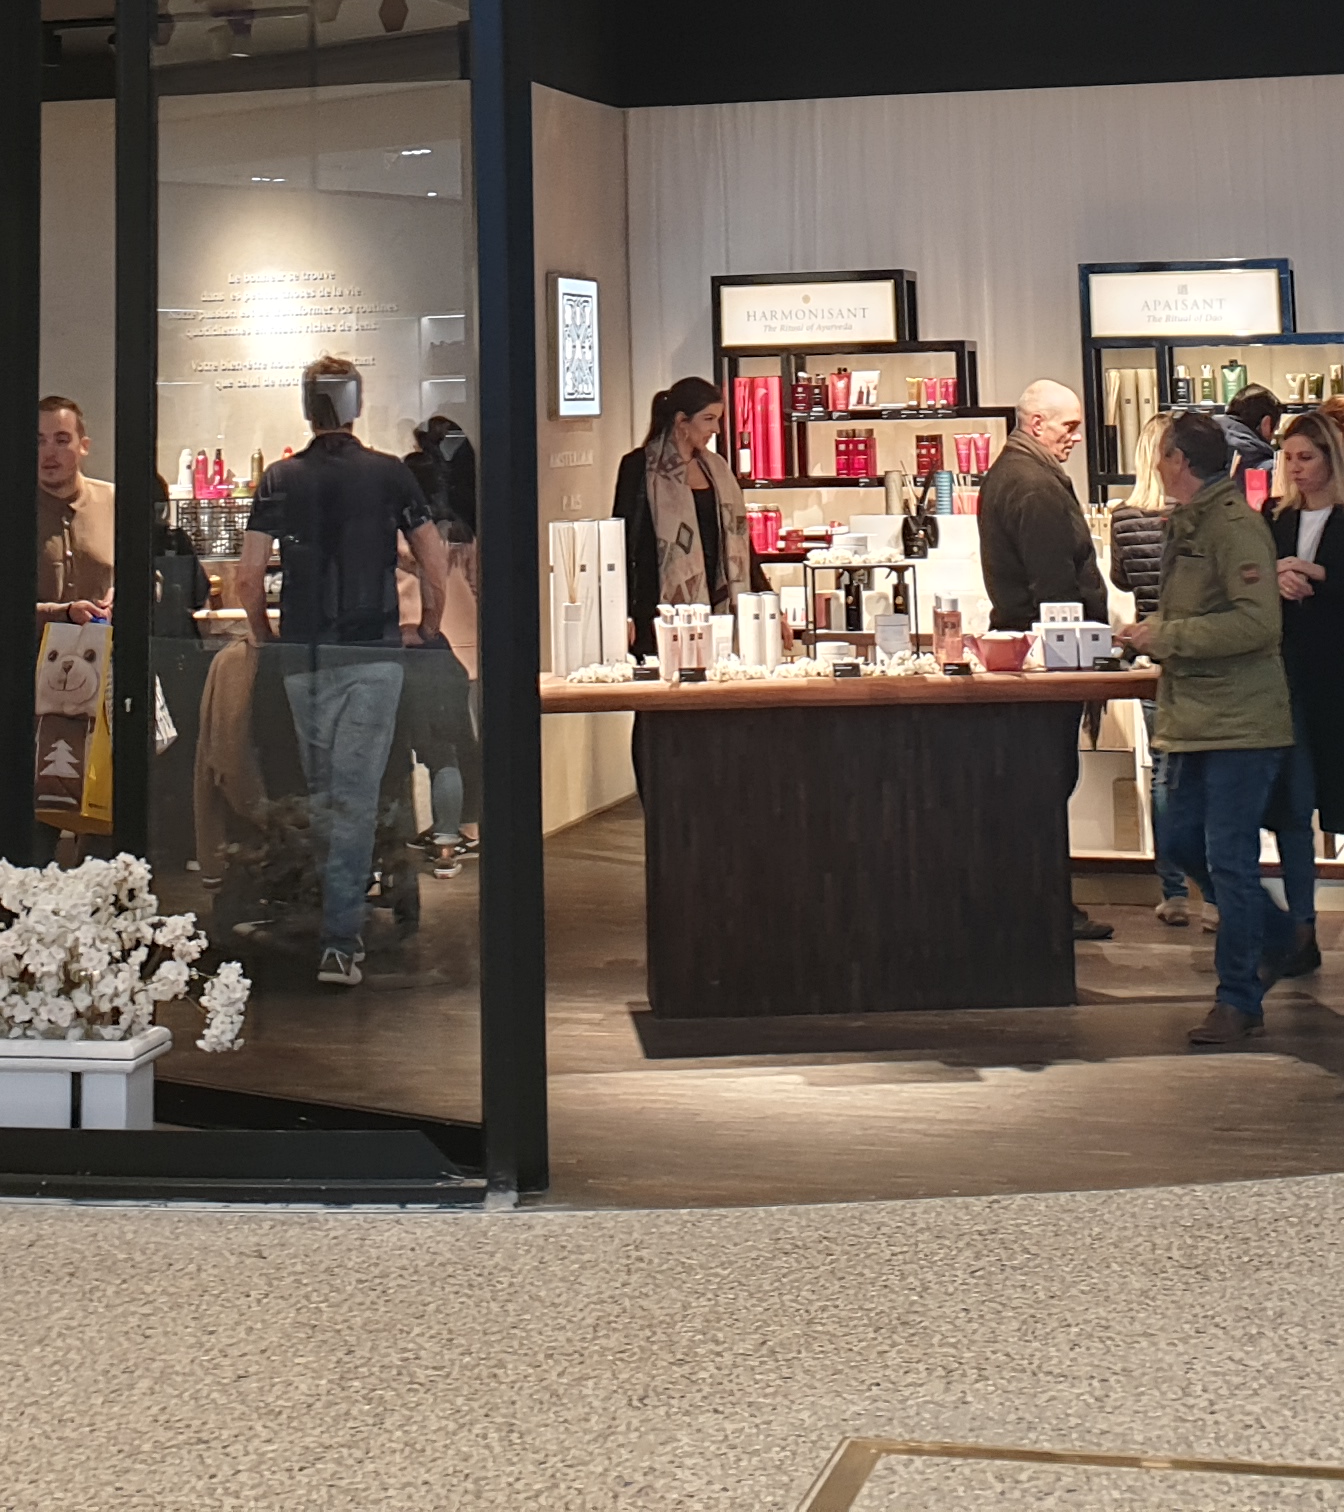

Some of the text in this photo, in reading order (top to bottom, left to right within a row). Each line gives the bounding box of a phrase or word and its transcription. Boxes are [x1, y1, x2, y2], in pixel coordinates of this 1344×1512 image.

[302, 270, 337, 282] trouve
[356, 301, 399, 314] routines
[1141, 298, 1226, 312] APAISANT
[746, 307, 870, 322] HARMONISANT
[1146, 314, 1163, 323] The
[1165, 314, 1192, 323] Ritual
[1194, 314, 1203, 323] of
[763, 324, 777, 333] The
[780, 323, 804, 332] Ritual
[816, 322, 853, 333] Ayurveda
